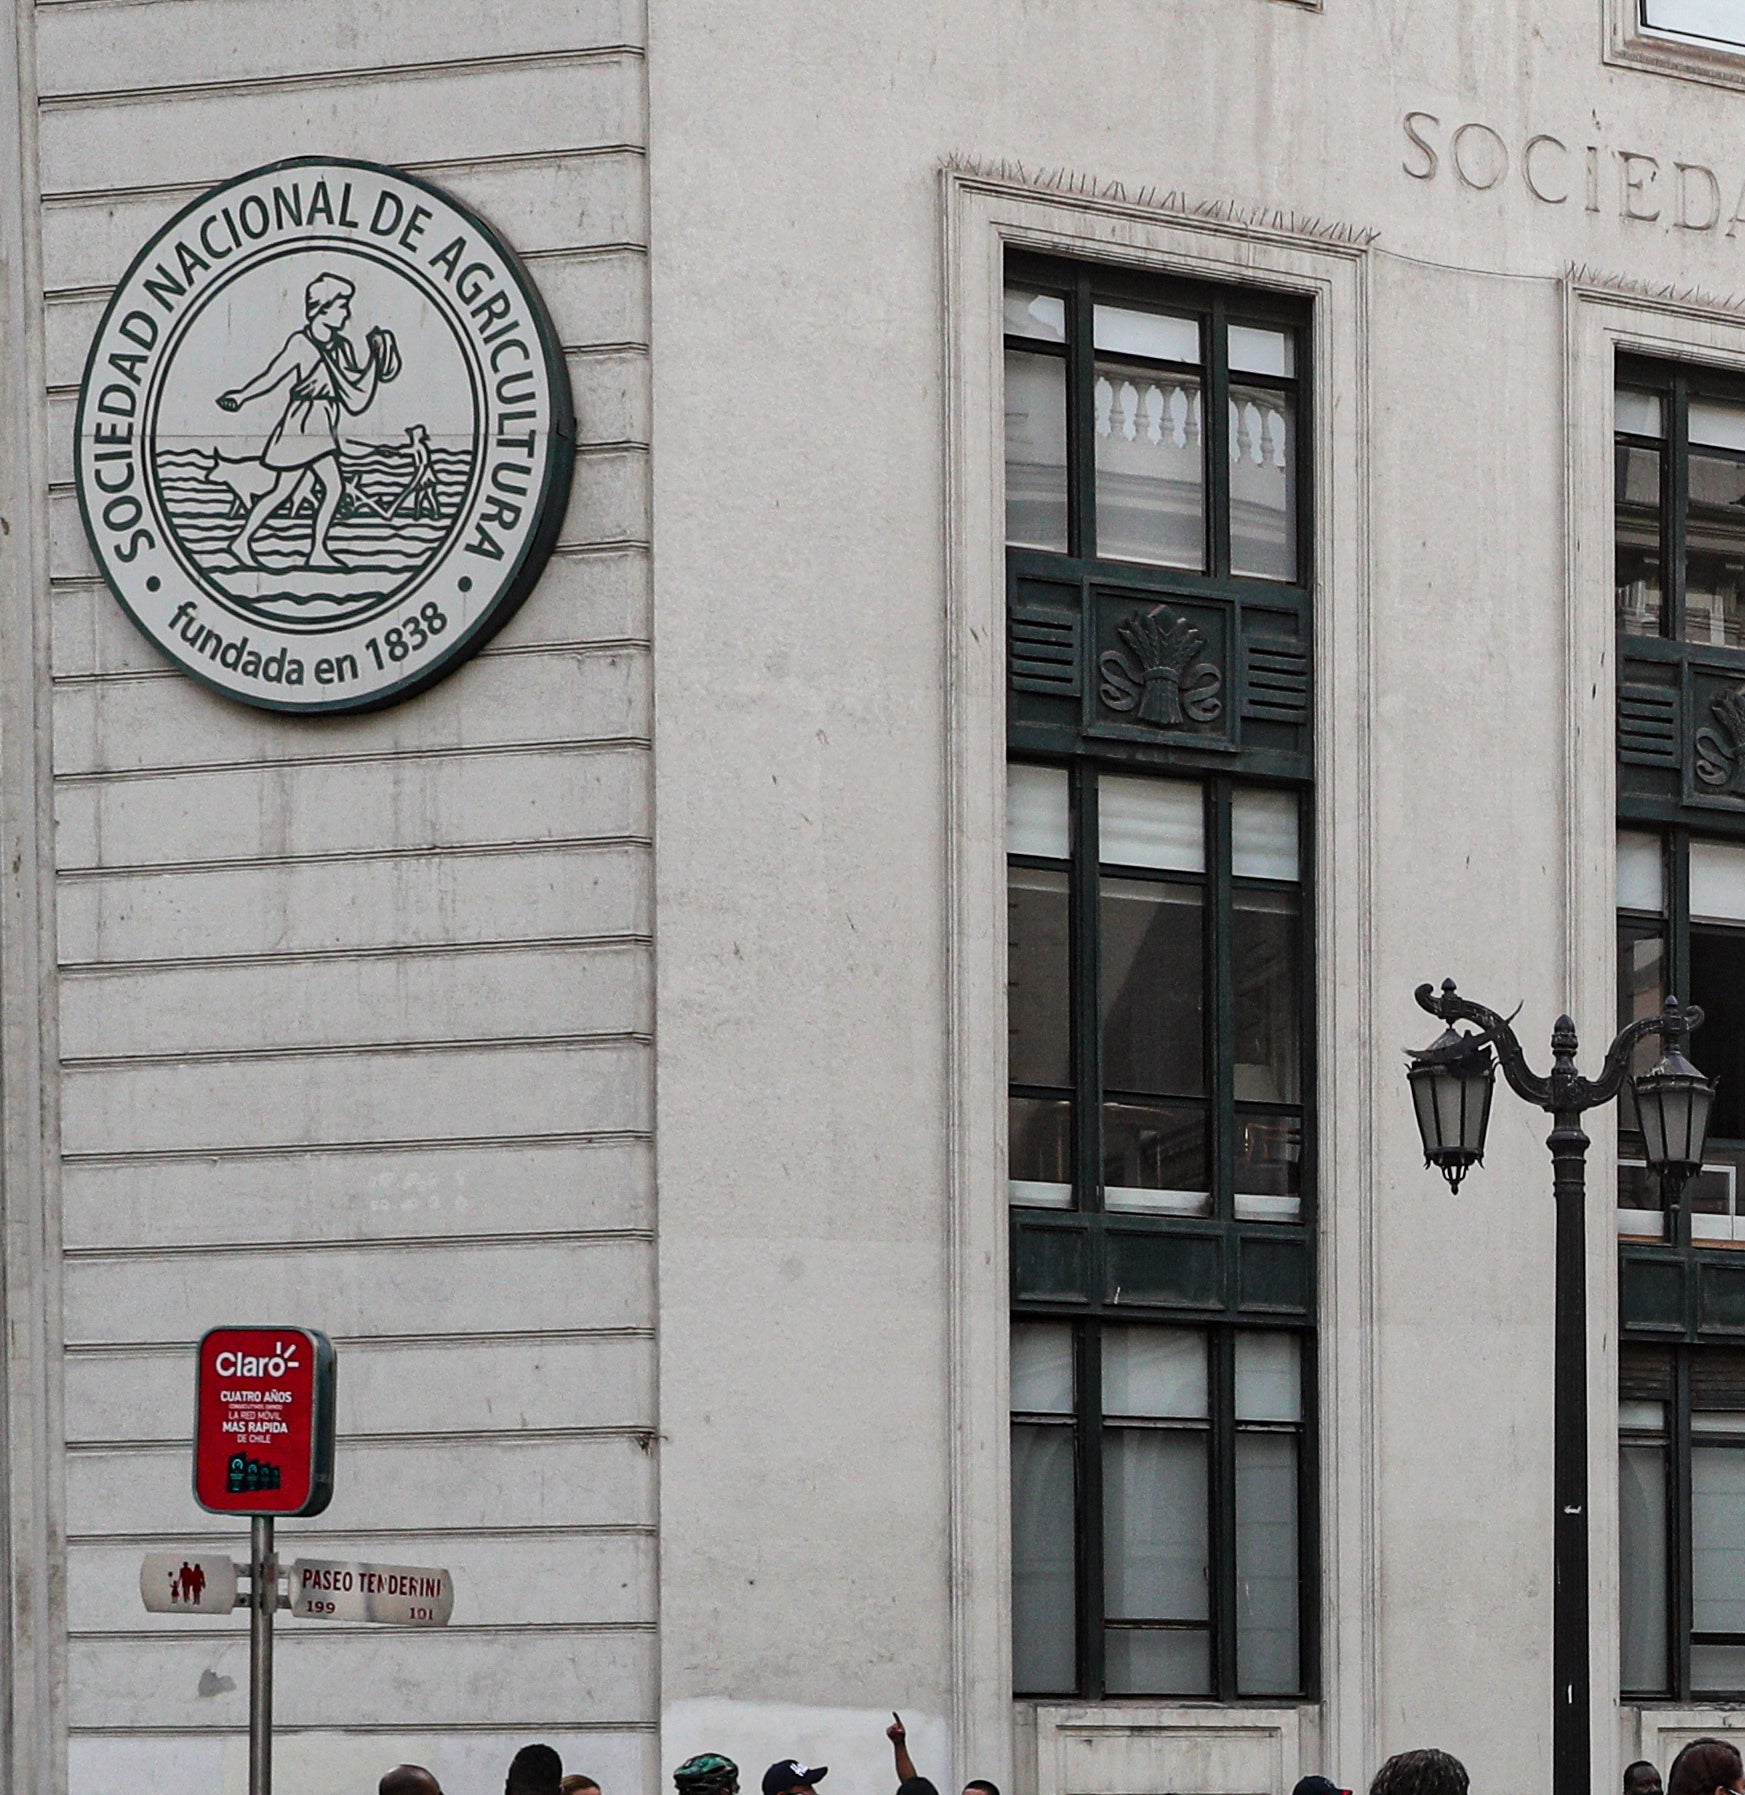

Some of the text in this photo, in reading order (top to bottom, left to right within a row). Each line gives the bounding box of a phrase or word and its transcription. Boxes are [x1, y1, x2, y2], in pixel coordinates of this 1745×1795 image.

[93, 181, 538, 565] SOCIEDAD NACIONAL DE AGRICULTURA
[167, 600, 449, 686] fundada en 1838
[215, 1350, 287, 1378] Claro
[220, 1388, 293, 1403] CUATRO AÑOS
[228, 1411, 239, 1420] LA
[237, 1434, 272, 1444] DE CHILE
[302, 1568, 353, 1592] PASEO
[306, 1600, 336, 1614] 199
